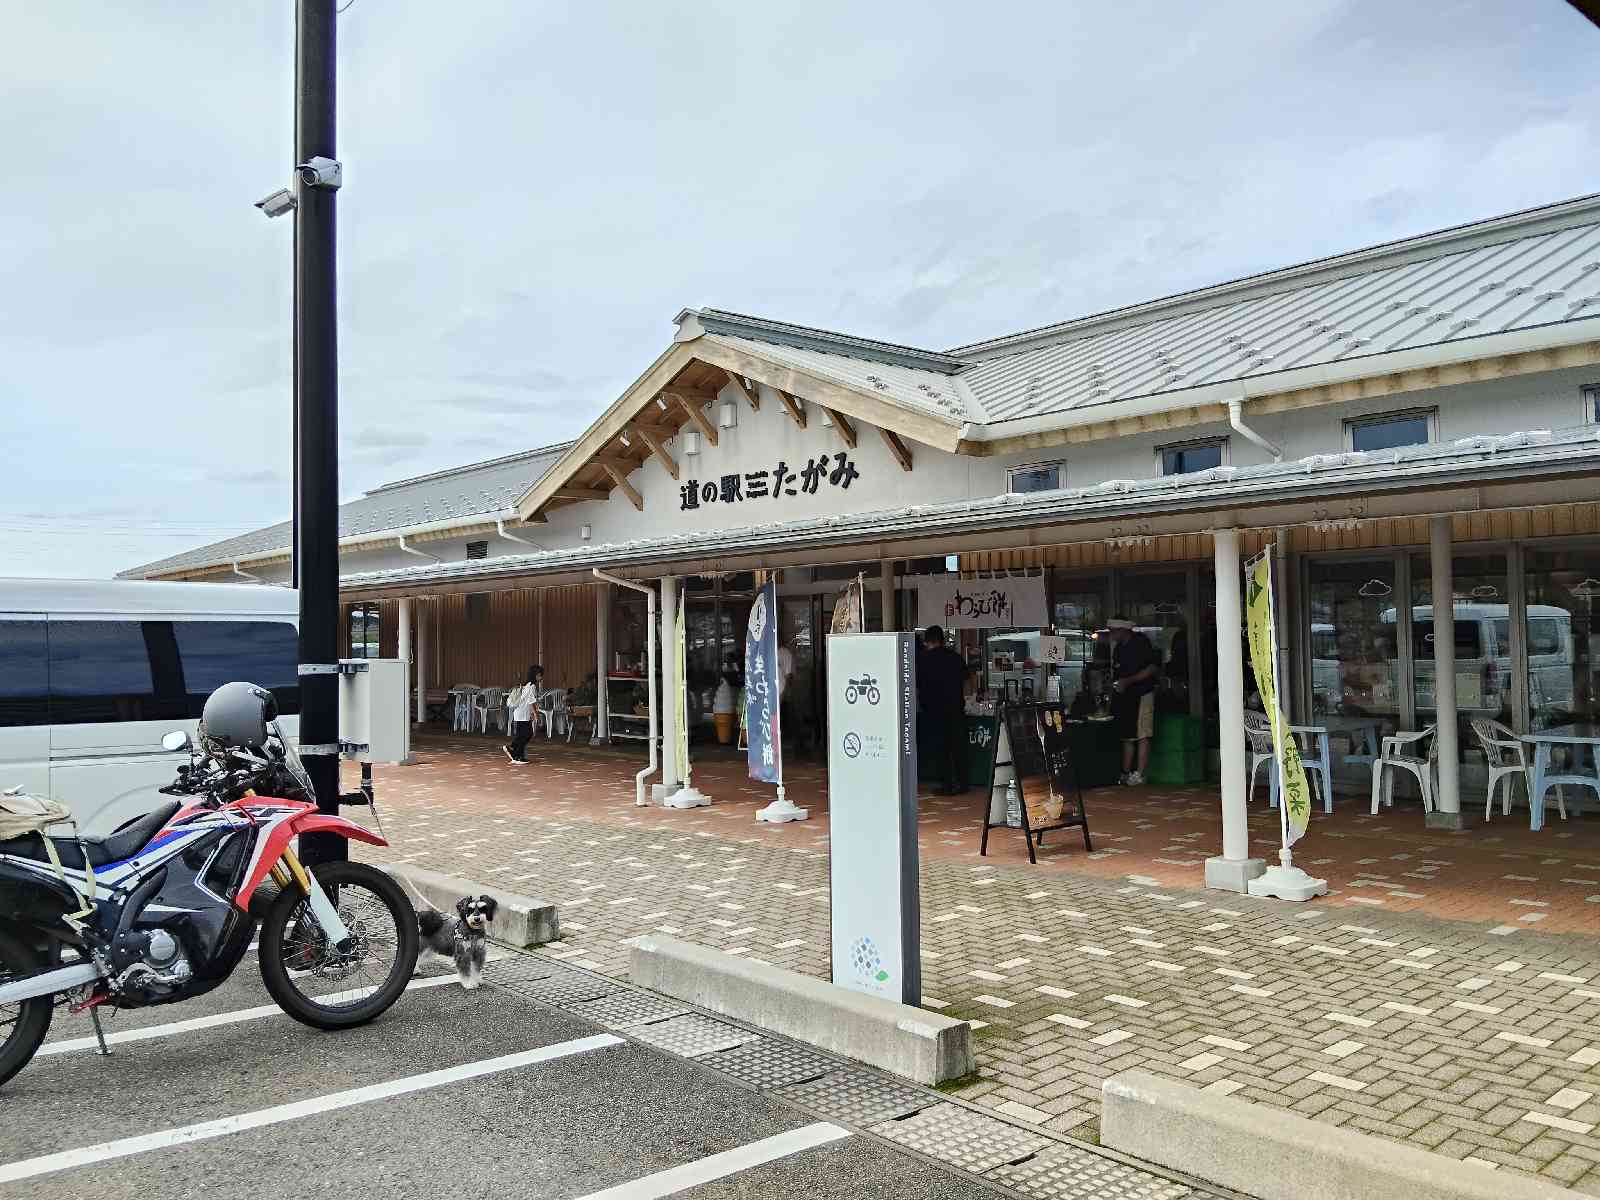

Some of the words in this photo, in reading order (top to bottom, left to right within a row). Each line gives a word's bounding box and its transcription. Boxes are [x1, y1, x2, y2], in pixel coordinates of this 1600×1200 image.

[679, 474, 744, 511] 道の駅
[772, 452, 860, 498] たがみ
